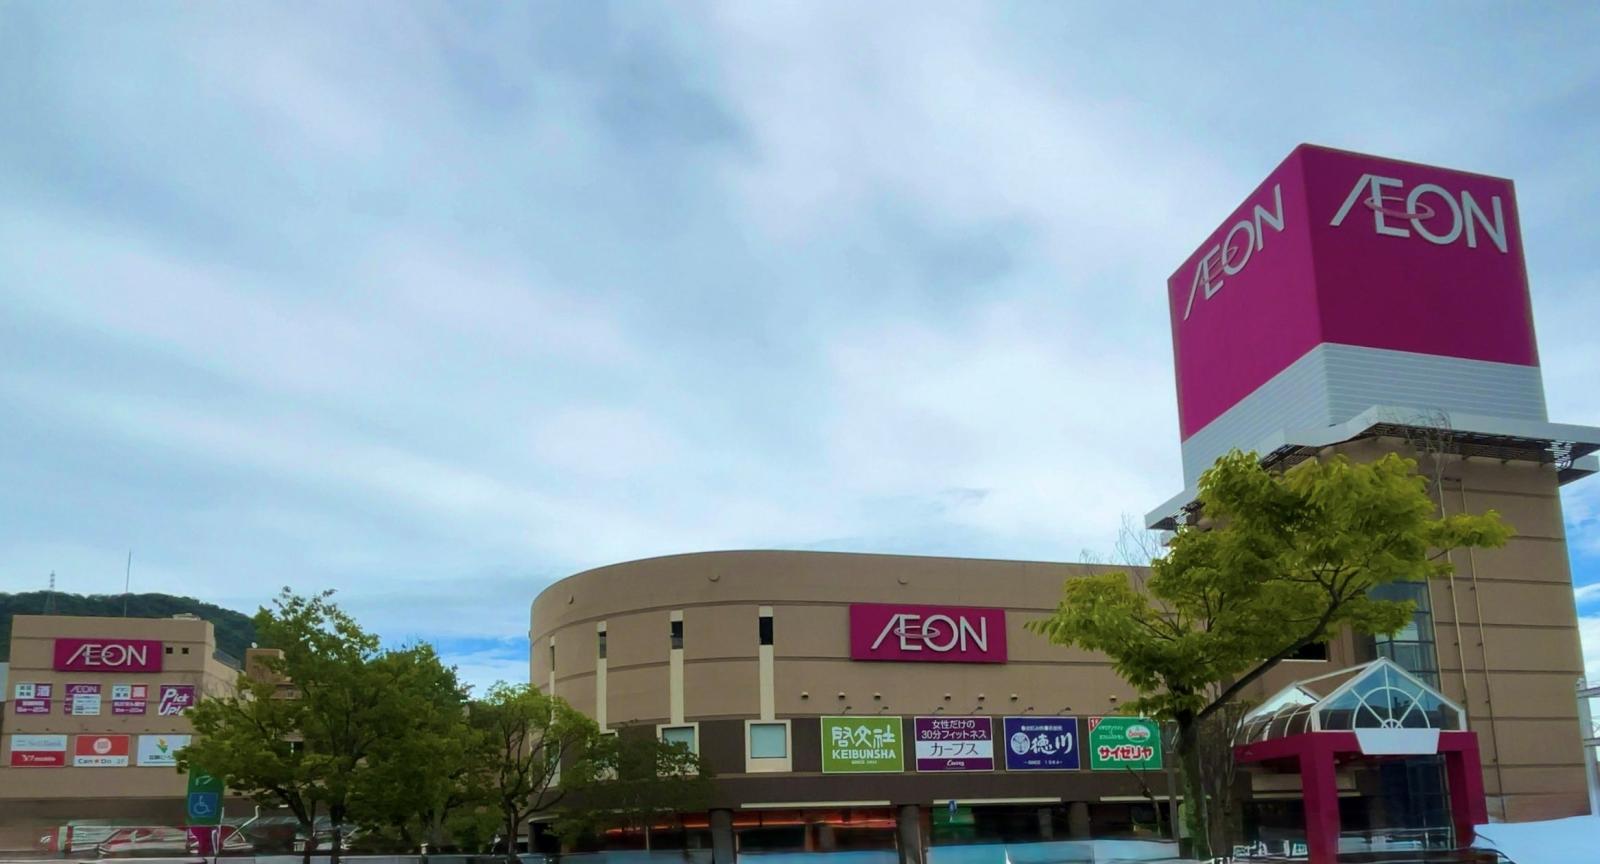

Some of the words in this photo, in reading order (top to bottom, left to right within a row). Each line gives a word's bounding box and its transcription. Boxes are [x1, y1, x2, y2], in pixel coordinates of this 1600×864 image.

[932, 720, 975, 729] 女性だけの
[921, 730, 987, 739] 30分フィットネス
[832, 749, 896, 759] KEIBUNSHA
[930, 742, 978, 756] カーブス
[1097, 745, 1153, 761] サイゼリヤ
